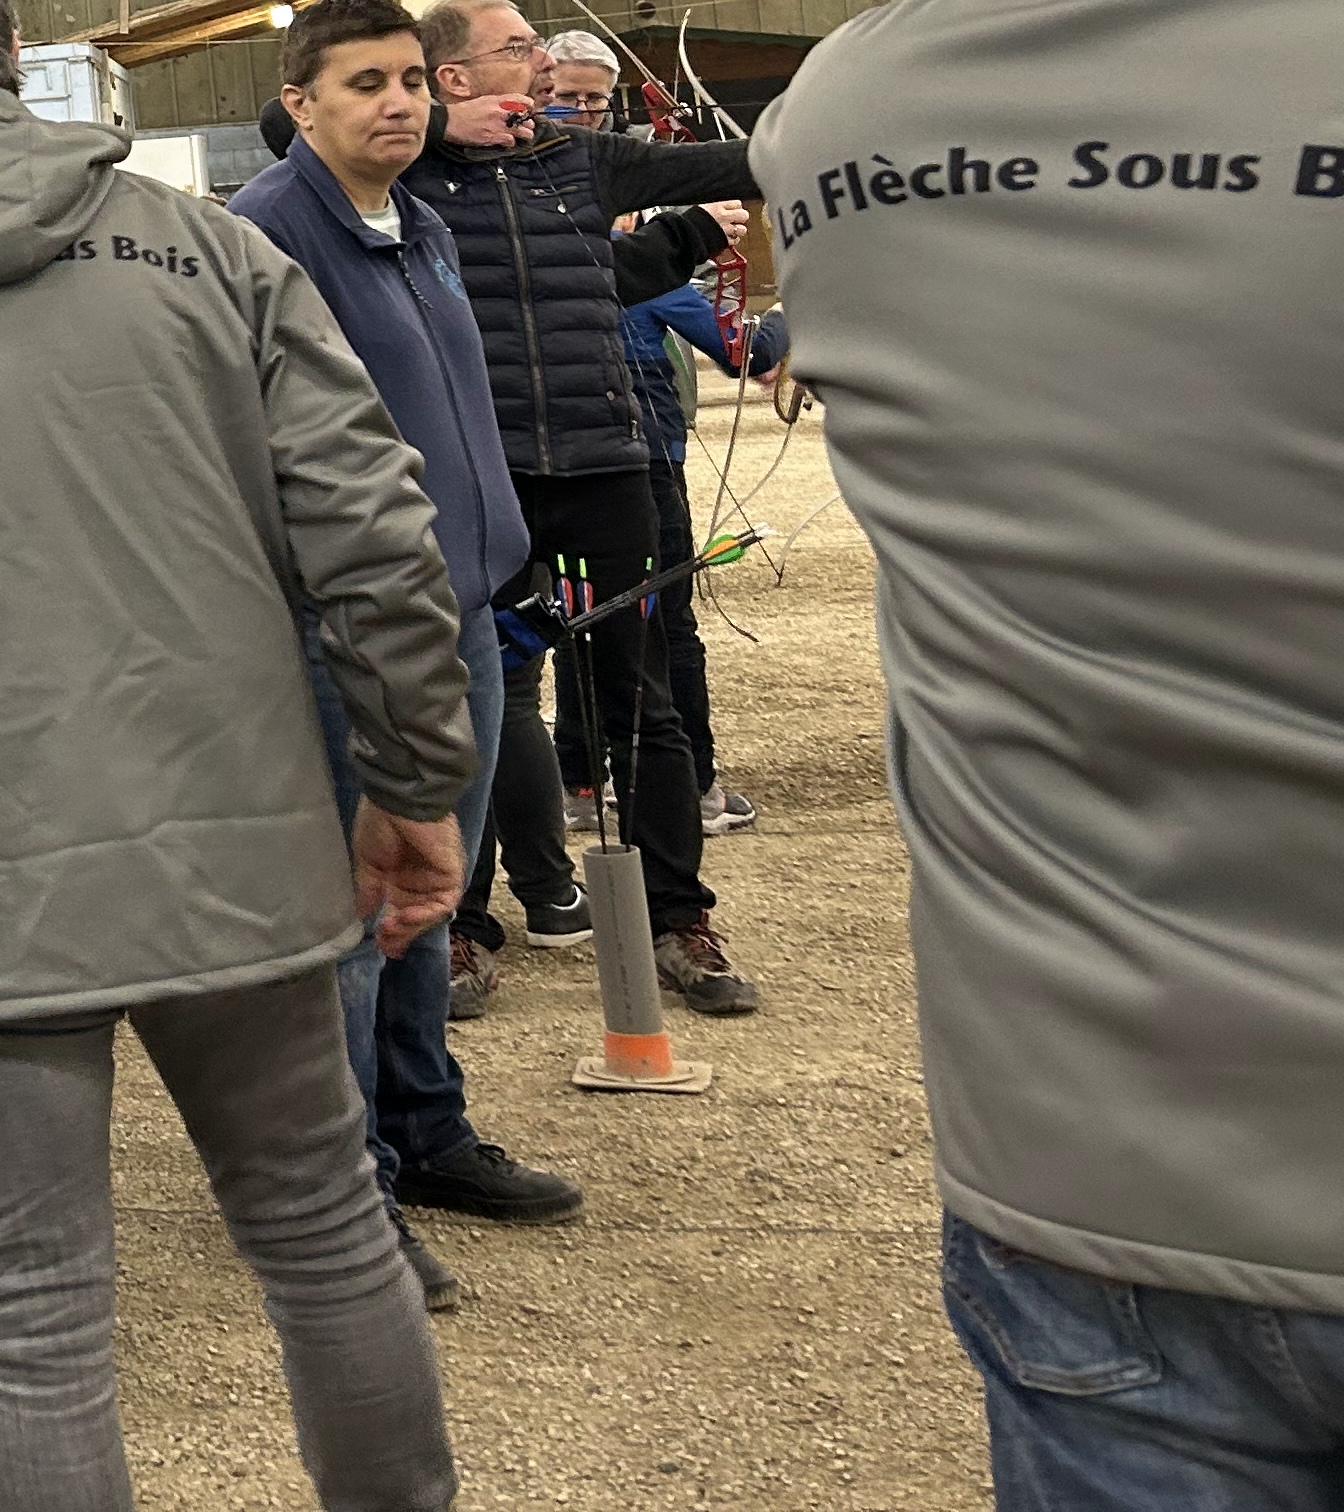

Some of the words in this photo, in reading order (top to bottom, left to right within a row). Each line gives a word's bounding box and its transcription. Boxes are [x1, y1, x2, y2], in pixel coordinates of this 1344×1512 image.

[777, 199, 812, 250] La
[817, 146, 1040, 219] Flèche
[1068, 140, 1261, 193] Sous
[111, 235, 200, 278] Bois
